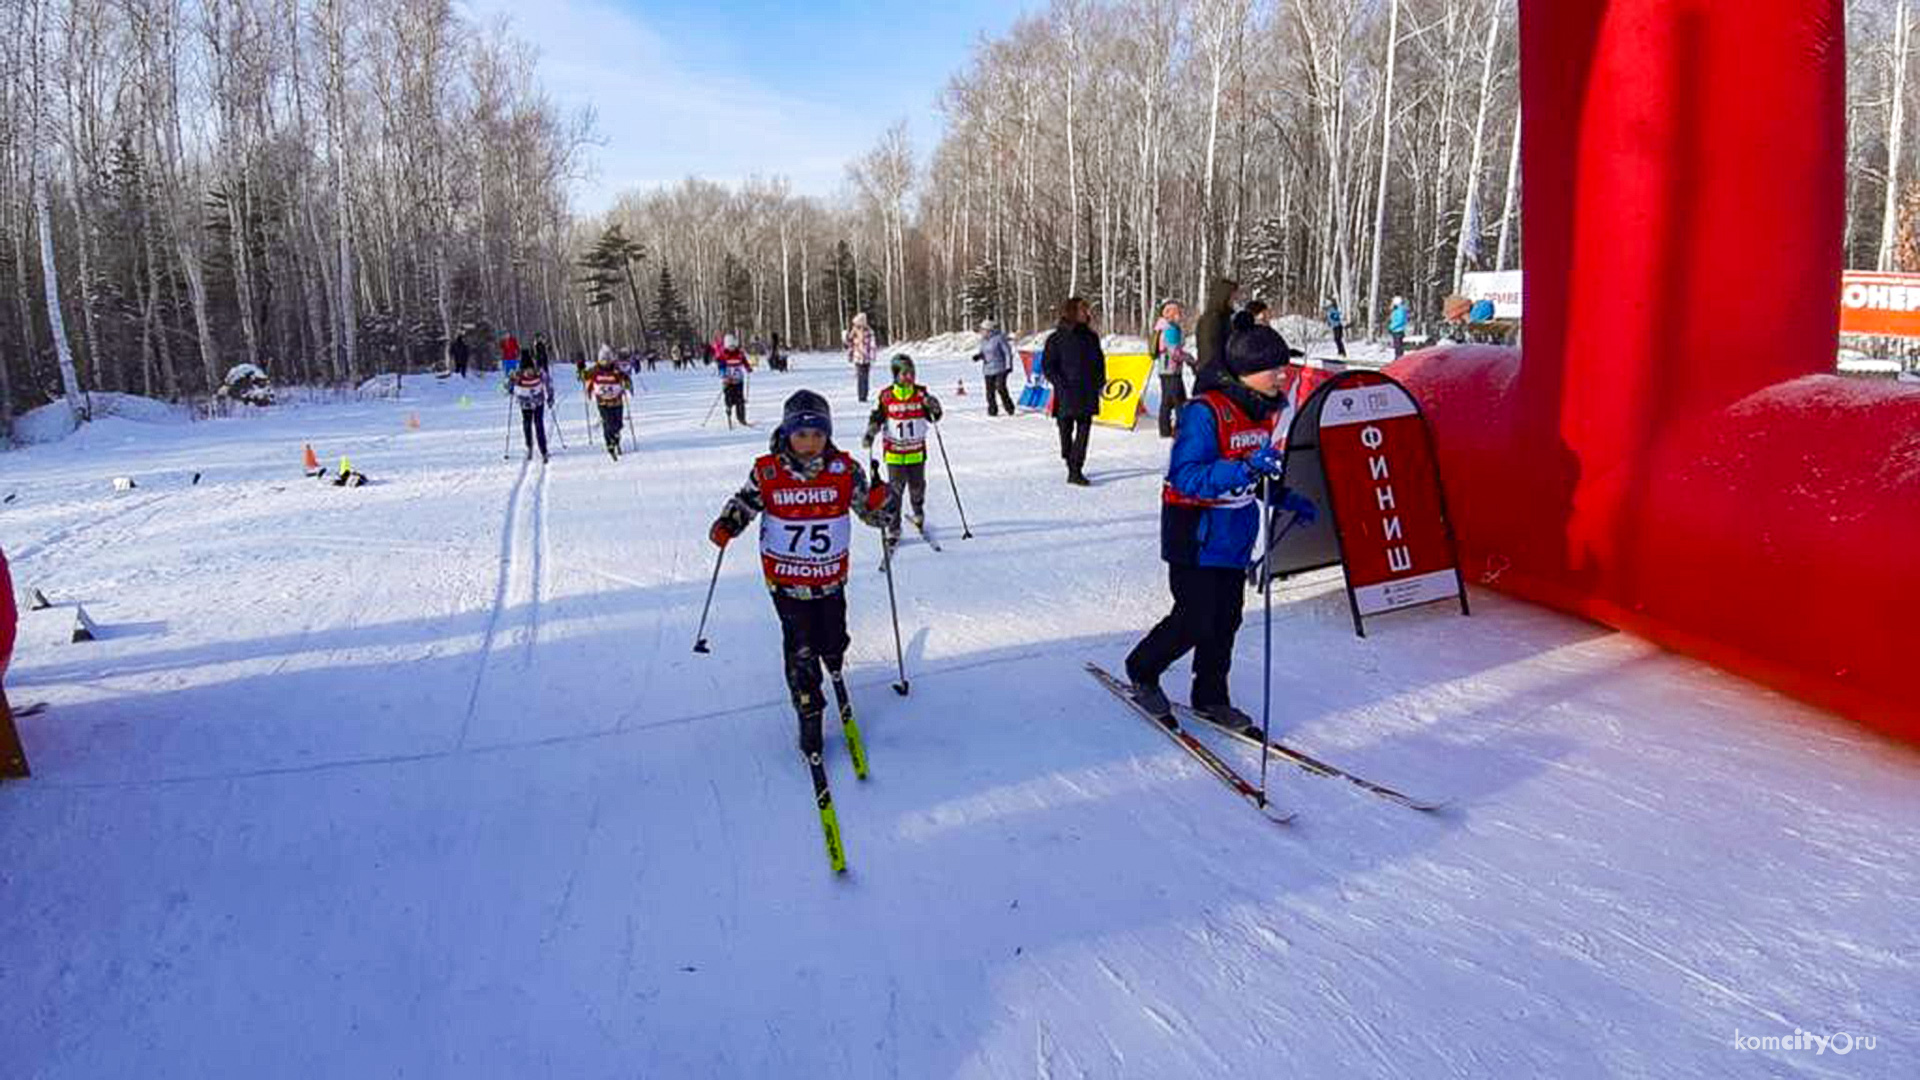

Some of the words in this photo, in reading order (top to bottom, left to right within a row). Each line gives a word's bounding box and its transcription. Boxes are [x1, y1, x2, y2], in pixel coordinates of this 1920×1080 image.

[896, 421, 915, 438] 11
[773, 489, 838, 505] ПИОНЕР
[1361, 425, 1411, 572] ФИНИШ
[784, 524, 832, 554] 75
